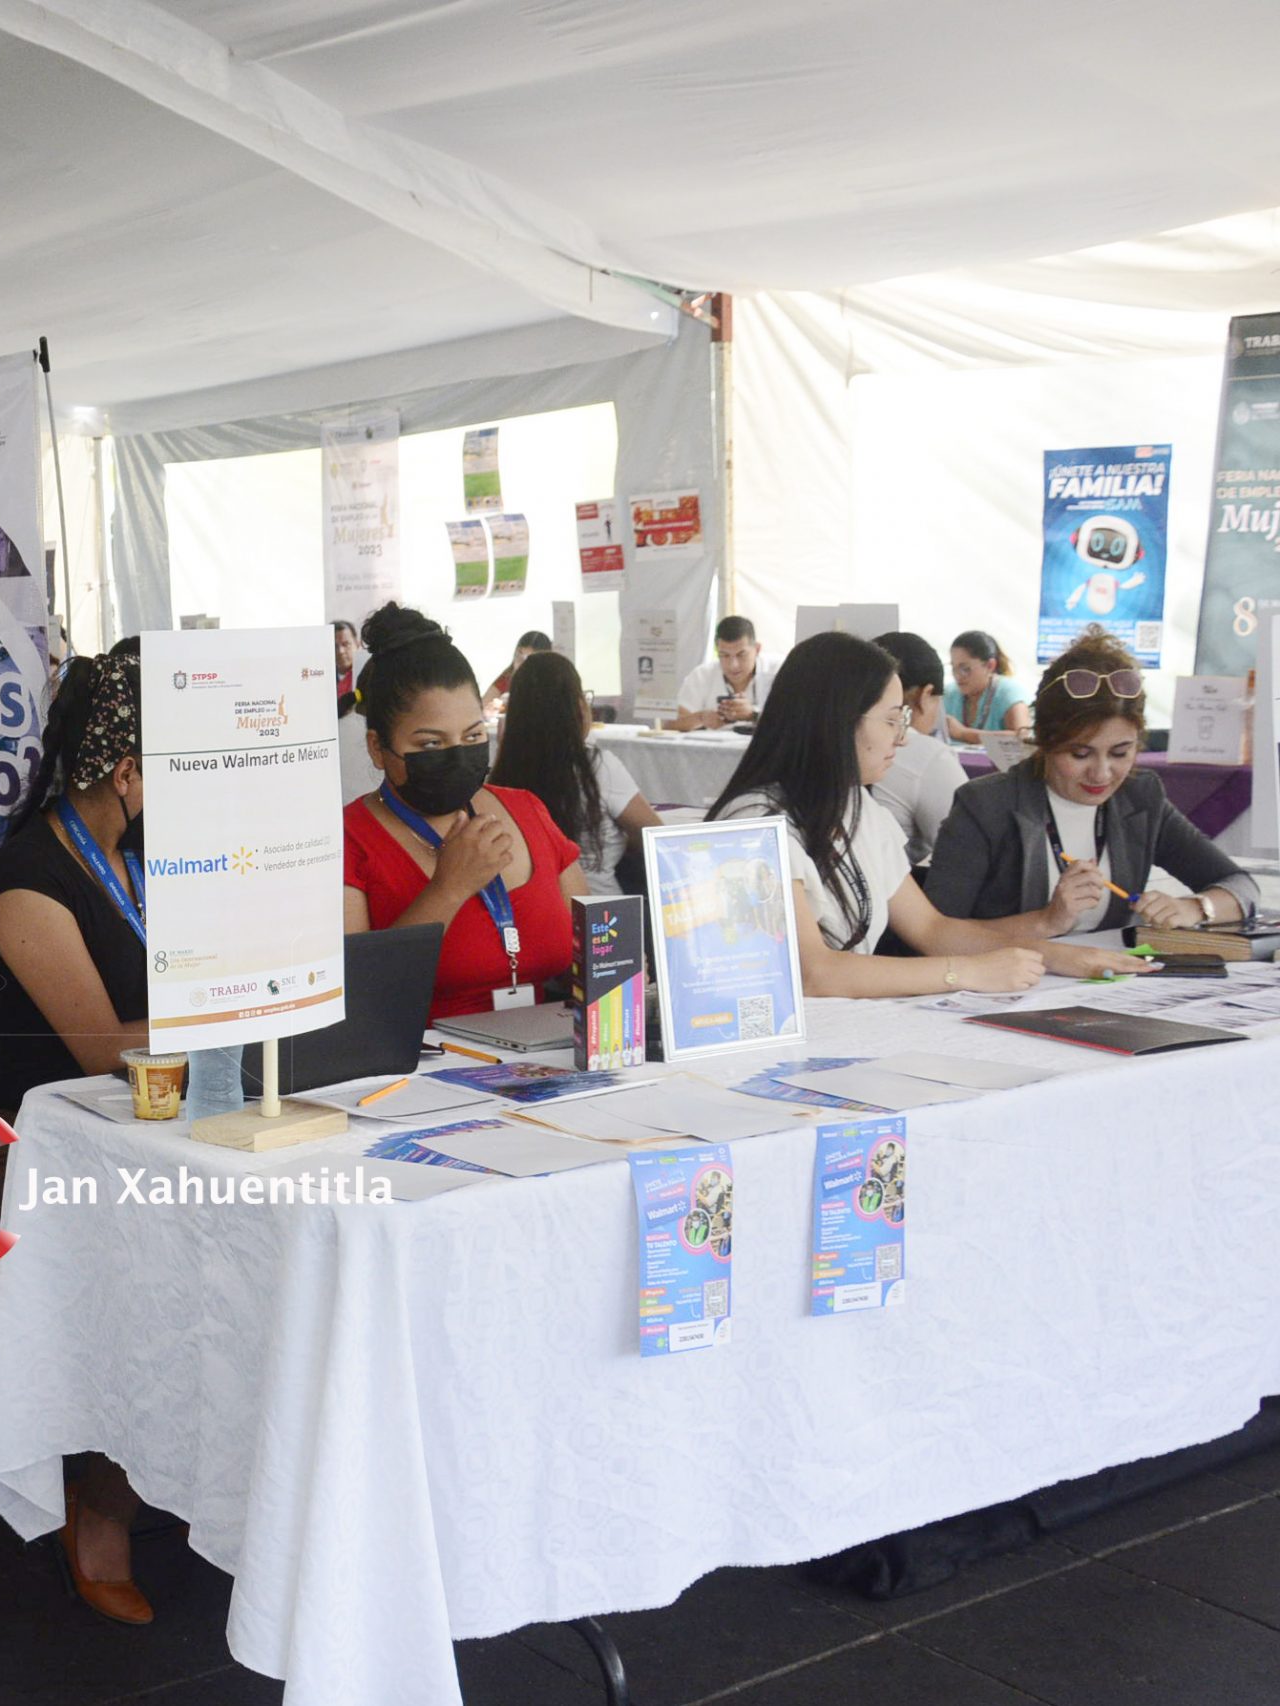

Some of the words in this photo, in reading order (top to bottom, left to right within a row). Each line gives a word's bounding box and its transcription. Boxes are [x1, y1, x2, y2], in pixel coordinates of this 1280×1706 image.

[1048, 474, 1164, 499] FAMILIA!
[333, 524, 384, 547] Mujeres
[358, 544, 382, 556] 2023
[1233, 595, 1258, 637] 8
[192, 672, 218, 681] STPSP
[235, 714, 281, 731] Mujeres
[259, 728, 280, 737] 2023
[169, 756, 218, 773] Nueva
[223, 751, 279, 769] Walmart
[282, 751, 295, 764] de
[298, 746, 329, 762] México
[264, 842, 294, 854] Asociado
[295, 840, 304, 850] de
[147, 854, 228, 877] Walmart
[264, 859, 296, 871] Vendedor
[298, 857, 306, 866] de
[592, 923, 609, 934] Este
[592, 936, 601, 944] es
[601, 933, 609, 943] el
[592, 944, 614, 957] lugar
[154, 950, 169, 973] 8
[281, 976, 296, 986] SNE
[210, 982, 258, 997] TRABAJO
[823, 1174, 853, 1190] Walmart
[647, 1204, 678, 1220] Walmart
[655, 1240, 677, 1249] TALENTO
